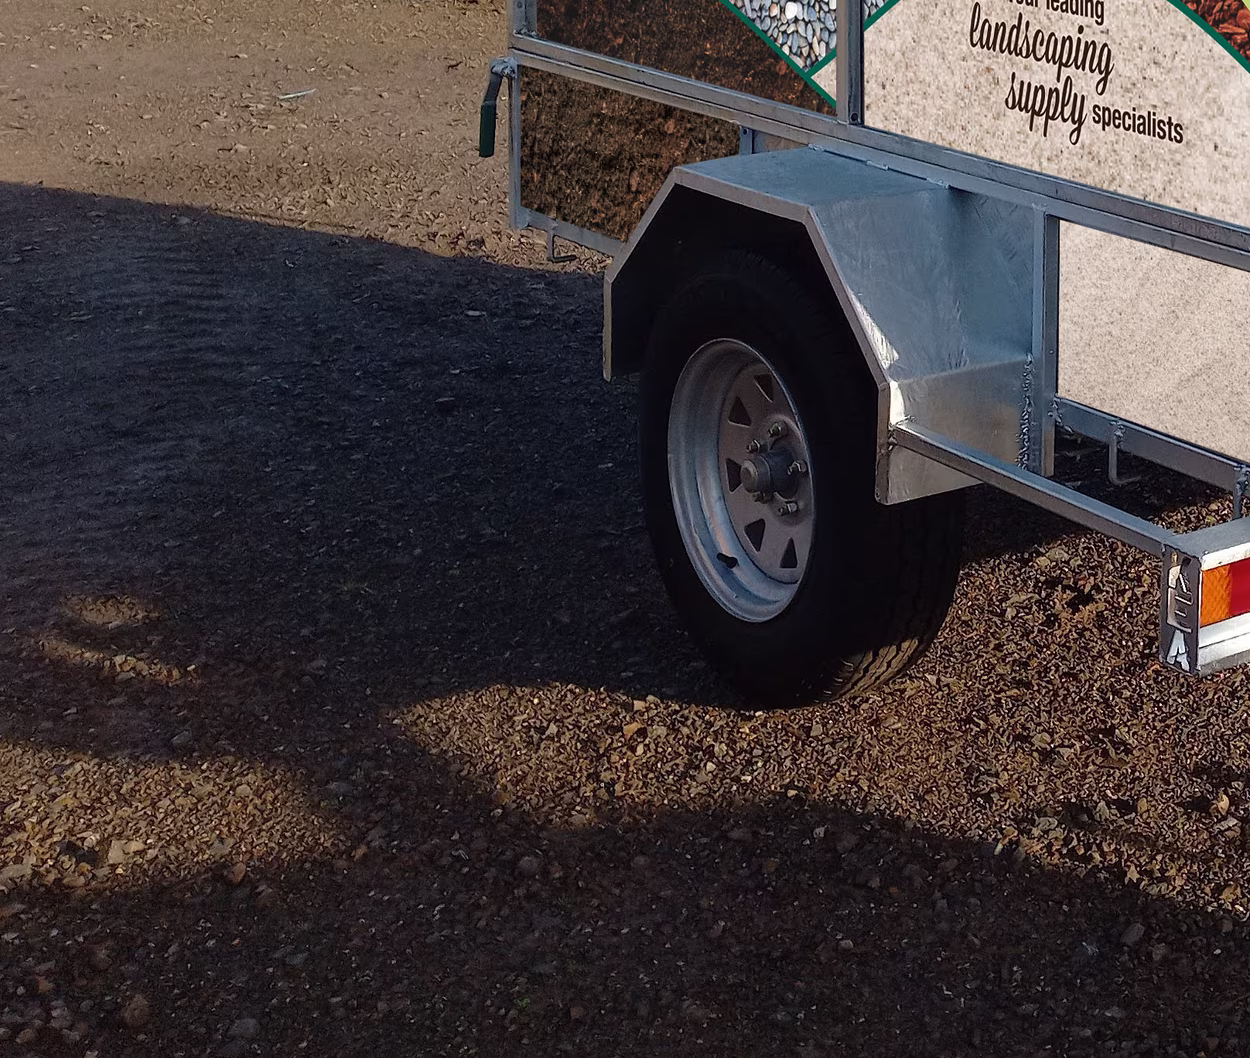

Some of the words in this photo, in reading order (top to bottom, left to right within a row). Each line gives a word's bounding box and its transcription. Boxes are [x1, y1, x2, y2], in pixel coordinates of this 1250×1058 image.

[969, 1, 1115, 96] landscaping
[1004, 71, 1088, 145] supply
[1092, 103, 1184, 144] specialists
